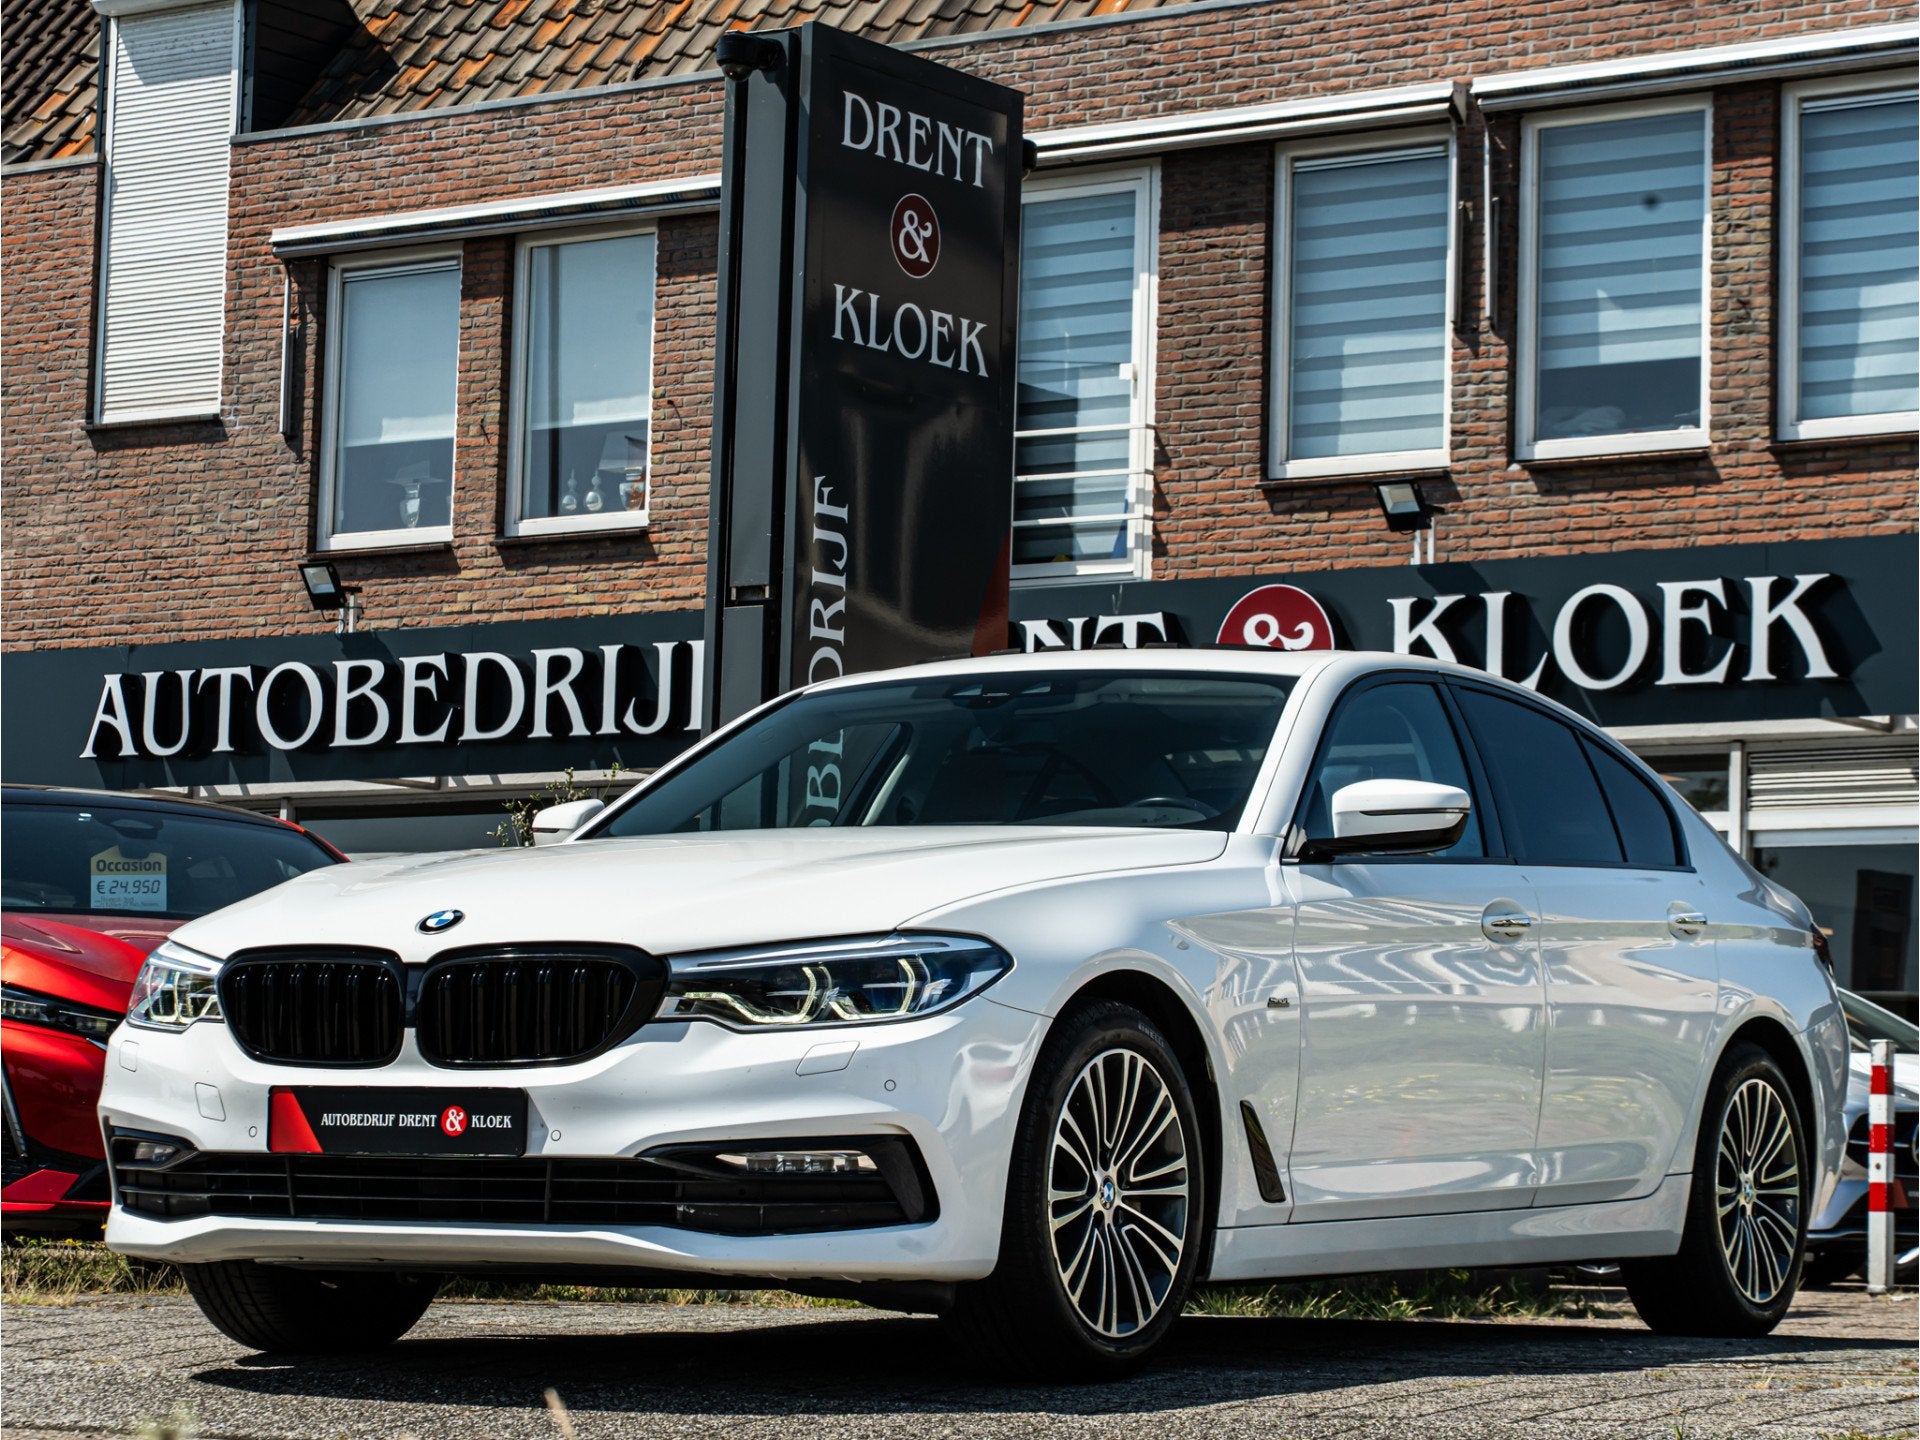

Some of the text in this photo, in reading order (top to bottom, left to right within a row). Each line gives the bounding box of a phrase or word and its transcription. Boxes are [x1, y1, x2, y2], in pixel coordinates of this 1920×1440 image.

[841, 91, 993, 188] DRENT
[899, 210, 932, 263] &
[832, 283, 989, 378] KLOEK
[1387, 573, 1838, 690] KLOEK
[96, 860, 162, 872] Occasion
[96, 880, 160, 894] € 24.950
[320, 1108, 512, 1132] AUTOBEDRIJF DRENT & KLOEK
